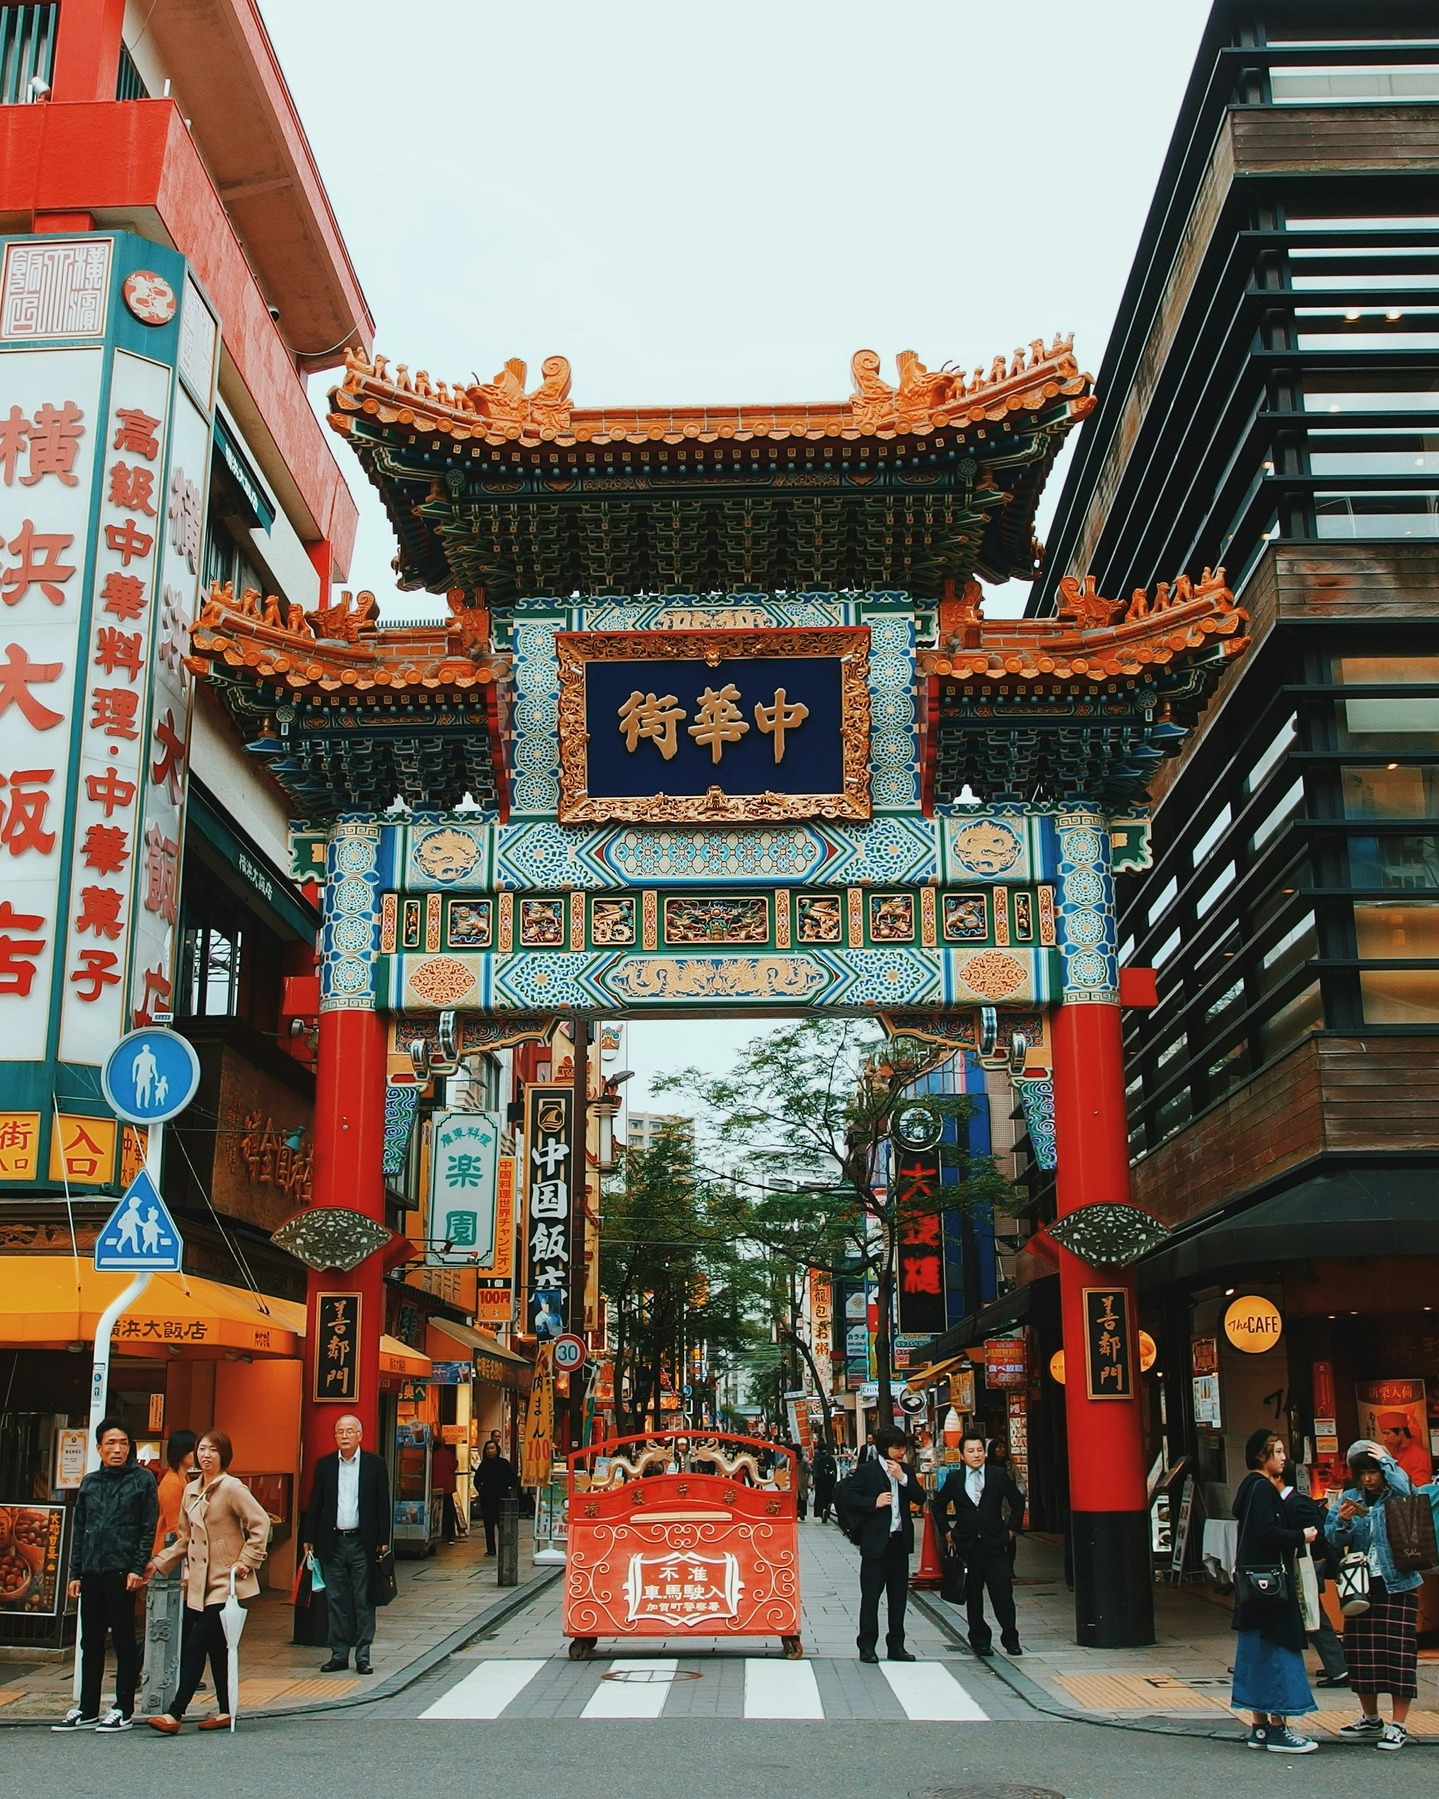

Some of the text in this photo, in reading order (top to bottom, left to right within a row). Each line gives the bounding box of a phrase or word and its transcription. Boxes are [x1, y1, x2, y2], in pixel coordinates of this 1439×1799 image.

[440, 1126, 492, 1149] 廣東料理
[63, 1124, 105, 1177] 入口
[445, 1154, 484, 1246] 楽園
[498, 1160, 512, 1276] 中国料理世界チャンピオン
[479, 1290, 511, 1304] 100円
[1228, 1316, 1278, 1333] The CAFE
[558, 1344, 578, 1361] 30
[533, 1373, 545, 1439] 肉まん
[527, 1440, 550, 1462] 100
[659, 1566, 708, 1582] 不准
[646, 1602, 720, 1612] 加賀町警察署
